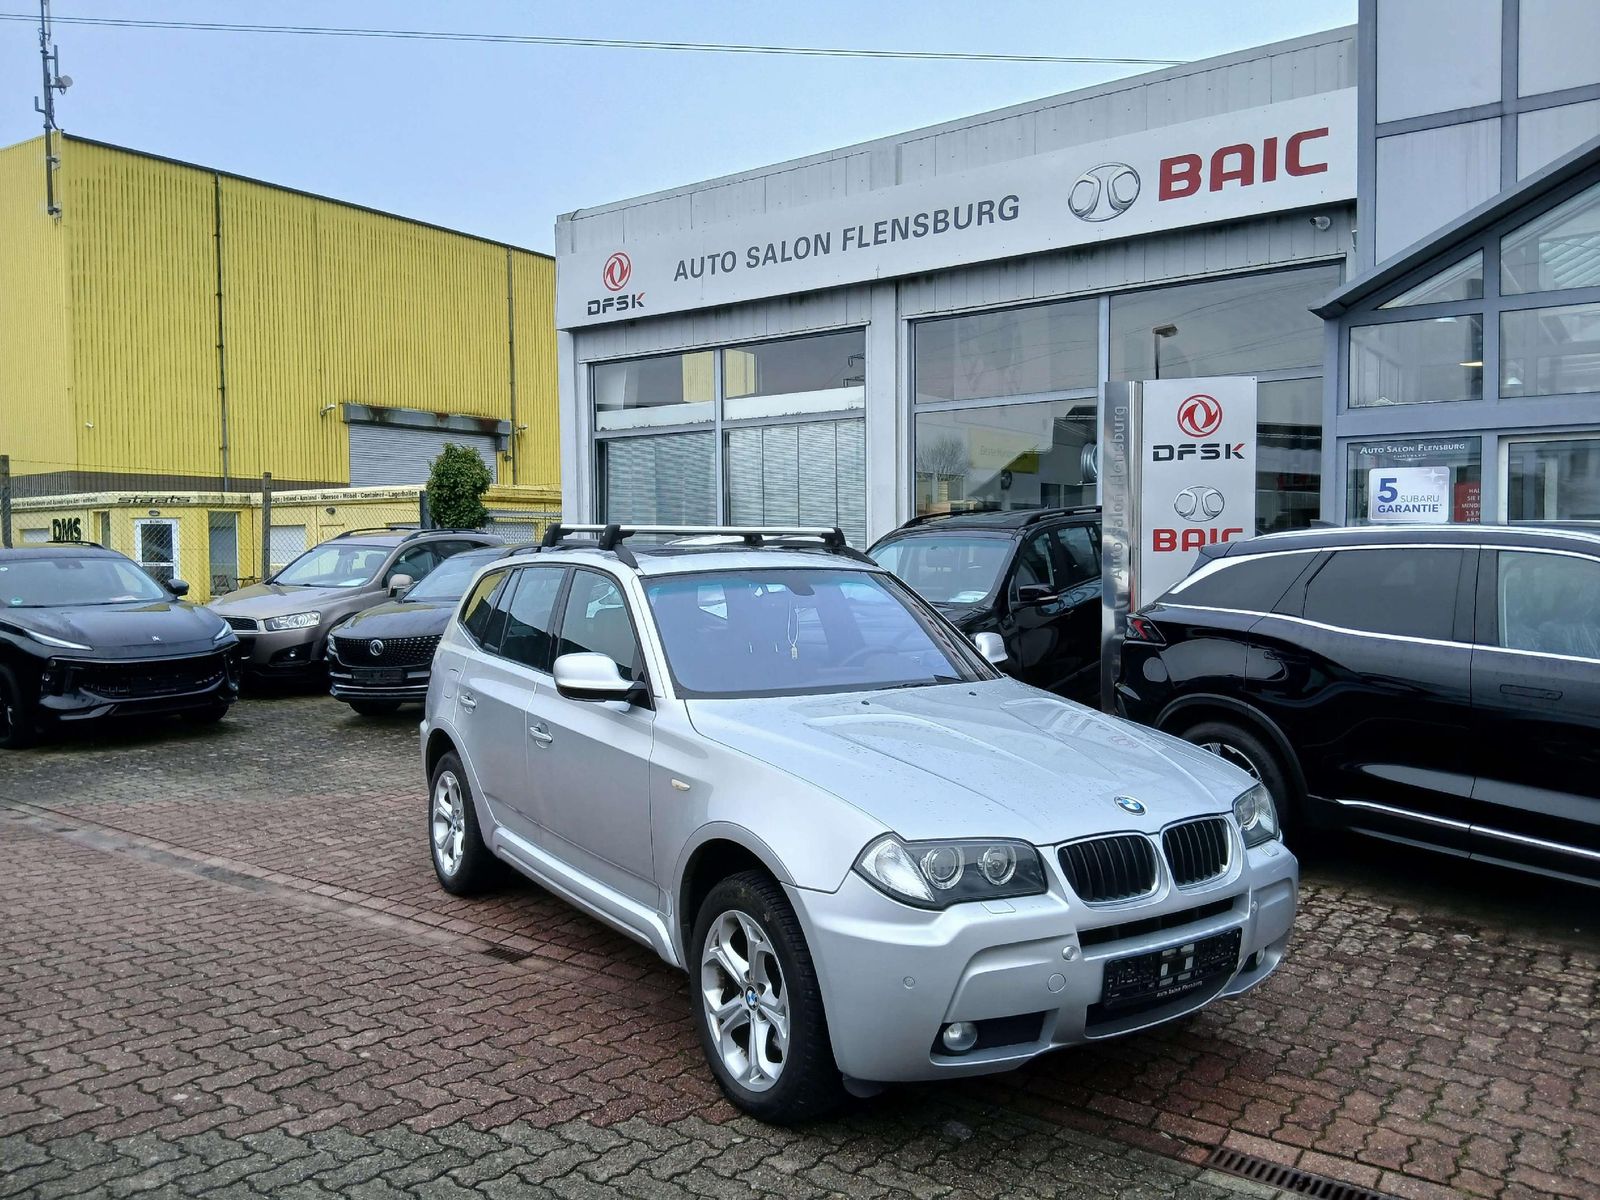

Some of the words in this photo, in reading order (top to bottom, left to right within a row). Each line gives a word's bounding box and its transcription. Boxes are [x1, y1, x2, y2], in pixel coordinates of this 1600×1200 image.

[1158, 127, 1329, 202] BAIC
[673, 251, 737, 282] AUTO
[746, 234, 830, 268] SALON
[843, 193, 1020, 252] FLENSBURG
[587, 292, 645, 316] DFSK
[1152, 443, 1246, 462] DFSK
[1360, 446, 1385, 454] AUTO
[1386, 445, 1415, 453] SALON
[1417, 443, 1465, 451] FLENSBURG
[1377, 477, 1398, 503] 5
[1400, 493, 1440, 503] SUBARU
[52, 518, 81, 541] DMS
